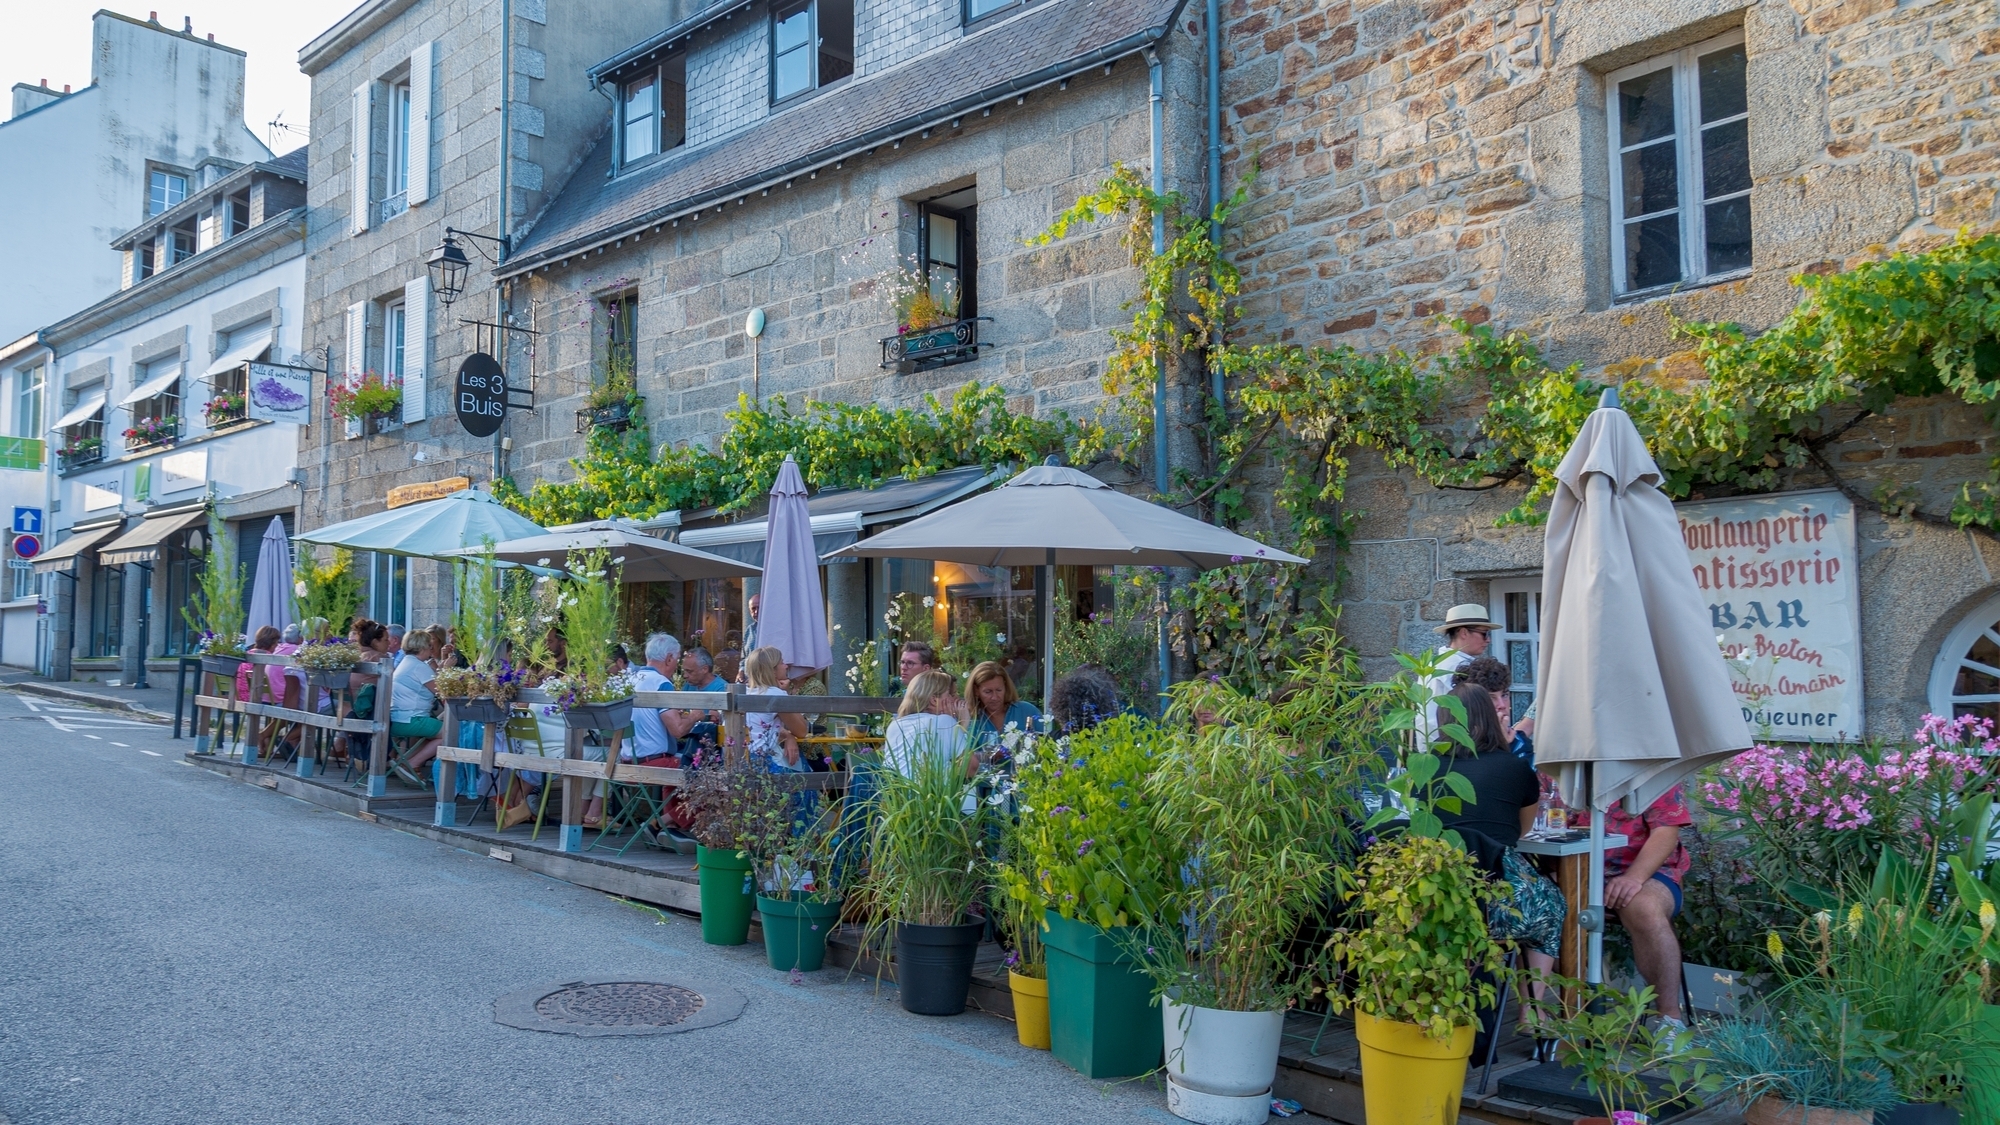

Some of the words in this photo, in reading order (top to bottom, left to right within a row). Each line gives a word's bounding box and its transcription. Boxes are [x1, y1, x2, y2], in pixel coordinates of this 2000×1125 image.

[288, 368, 310, 382] Pierres
[461, 371, 486, 388] Les
[490, 375, 503, 394] 3
[461, 392, 503, 417] Buis
[1692, 550, 1840, 590] atisserie
[1708, 599, 1810, 630] BAR
[1754, 634, 1822, 667] Breton
[1741, 707, 1838, 727] Déjeuner
